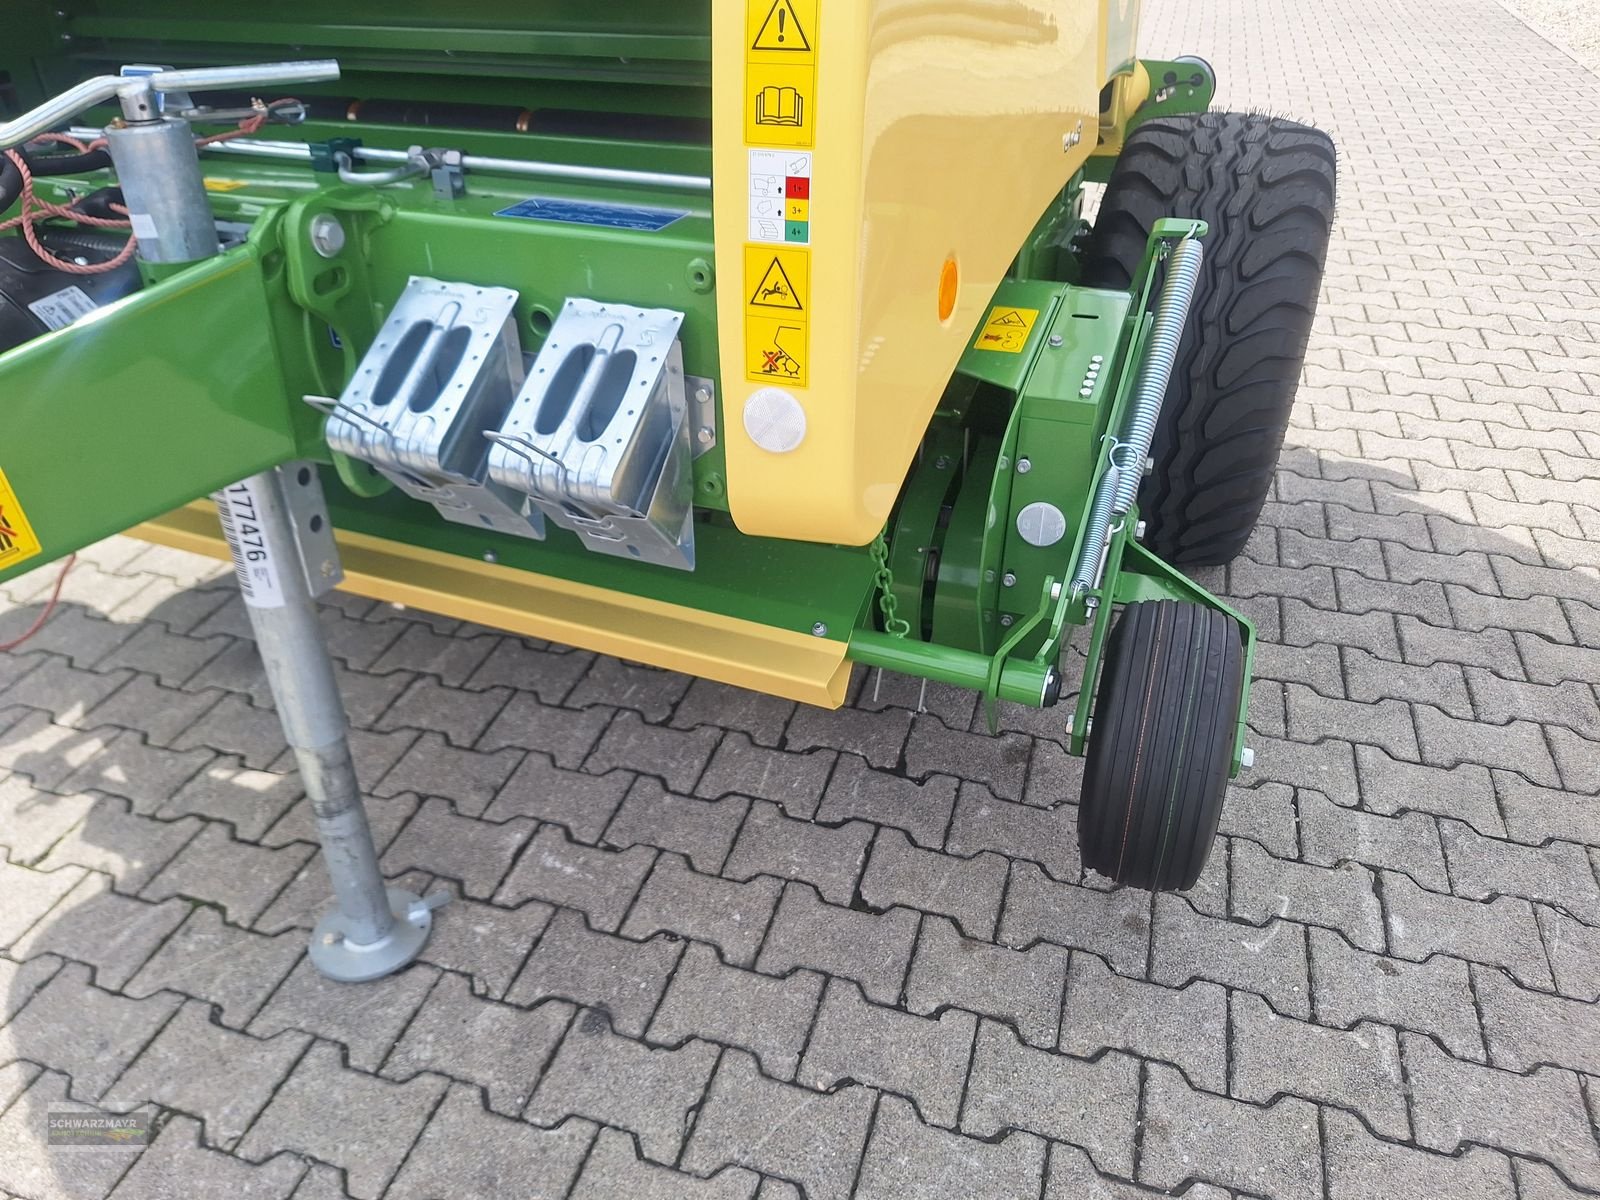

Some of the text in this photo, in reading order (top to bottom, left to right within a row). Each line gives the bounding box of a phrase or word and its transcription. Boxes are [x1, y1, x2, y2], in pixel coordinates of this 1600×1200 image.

[792, 206, 802, 215] 3+
[791, 228, 801, 236] 4+
[228, 483, 267, 562] 177476
